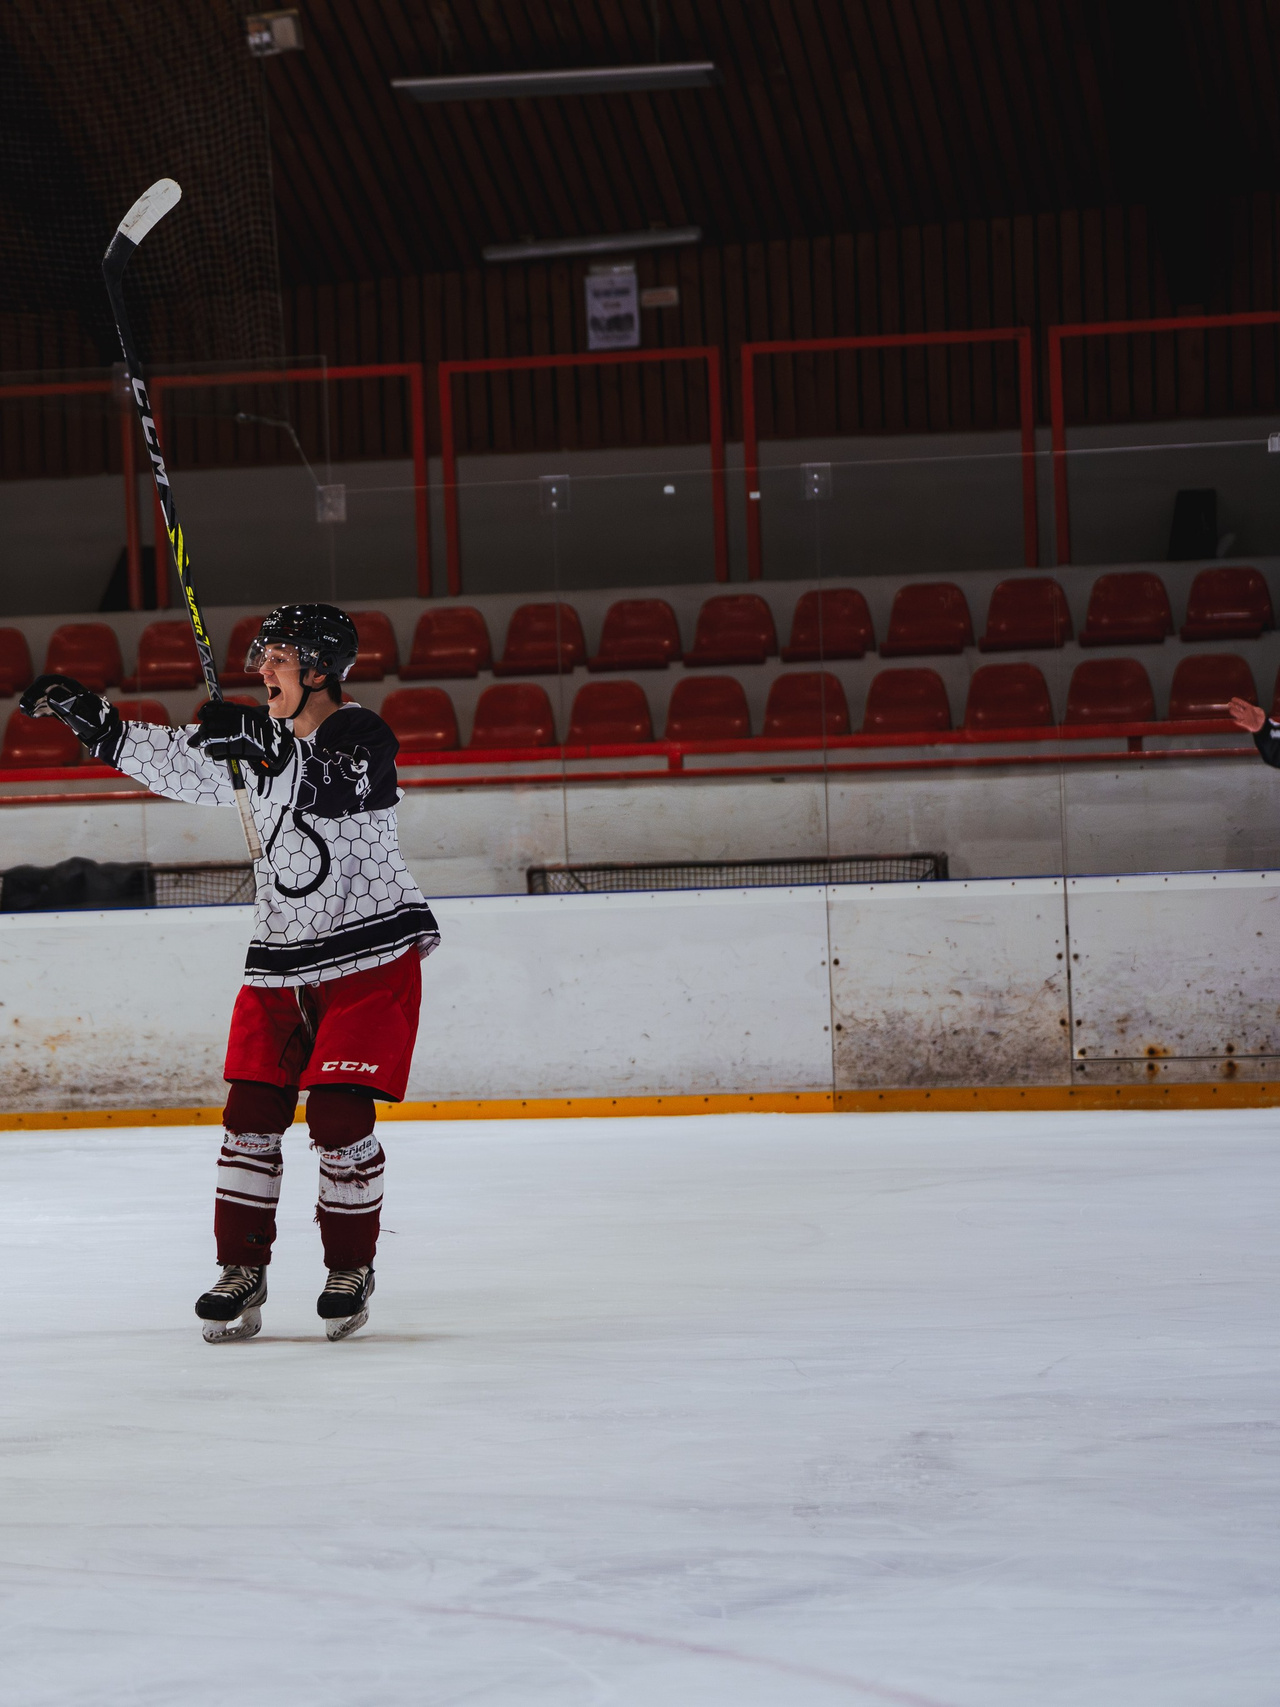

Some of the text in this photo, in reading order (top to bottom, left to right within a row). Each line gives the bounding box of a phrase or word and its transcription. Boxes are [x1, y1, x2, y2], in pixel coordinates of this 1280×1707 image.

[131, 376, 170, 488] CCM
[185, 585, 204, 637] SUPER
[321, 1060, 380, 1074] CCM
